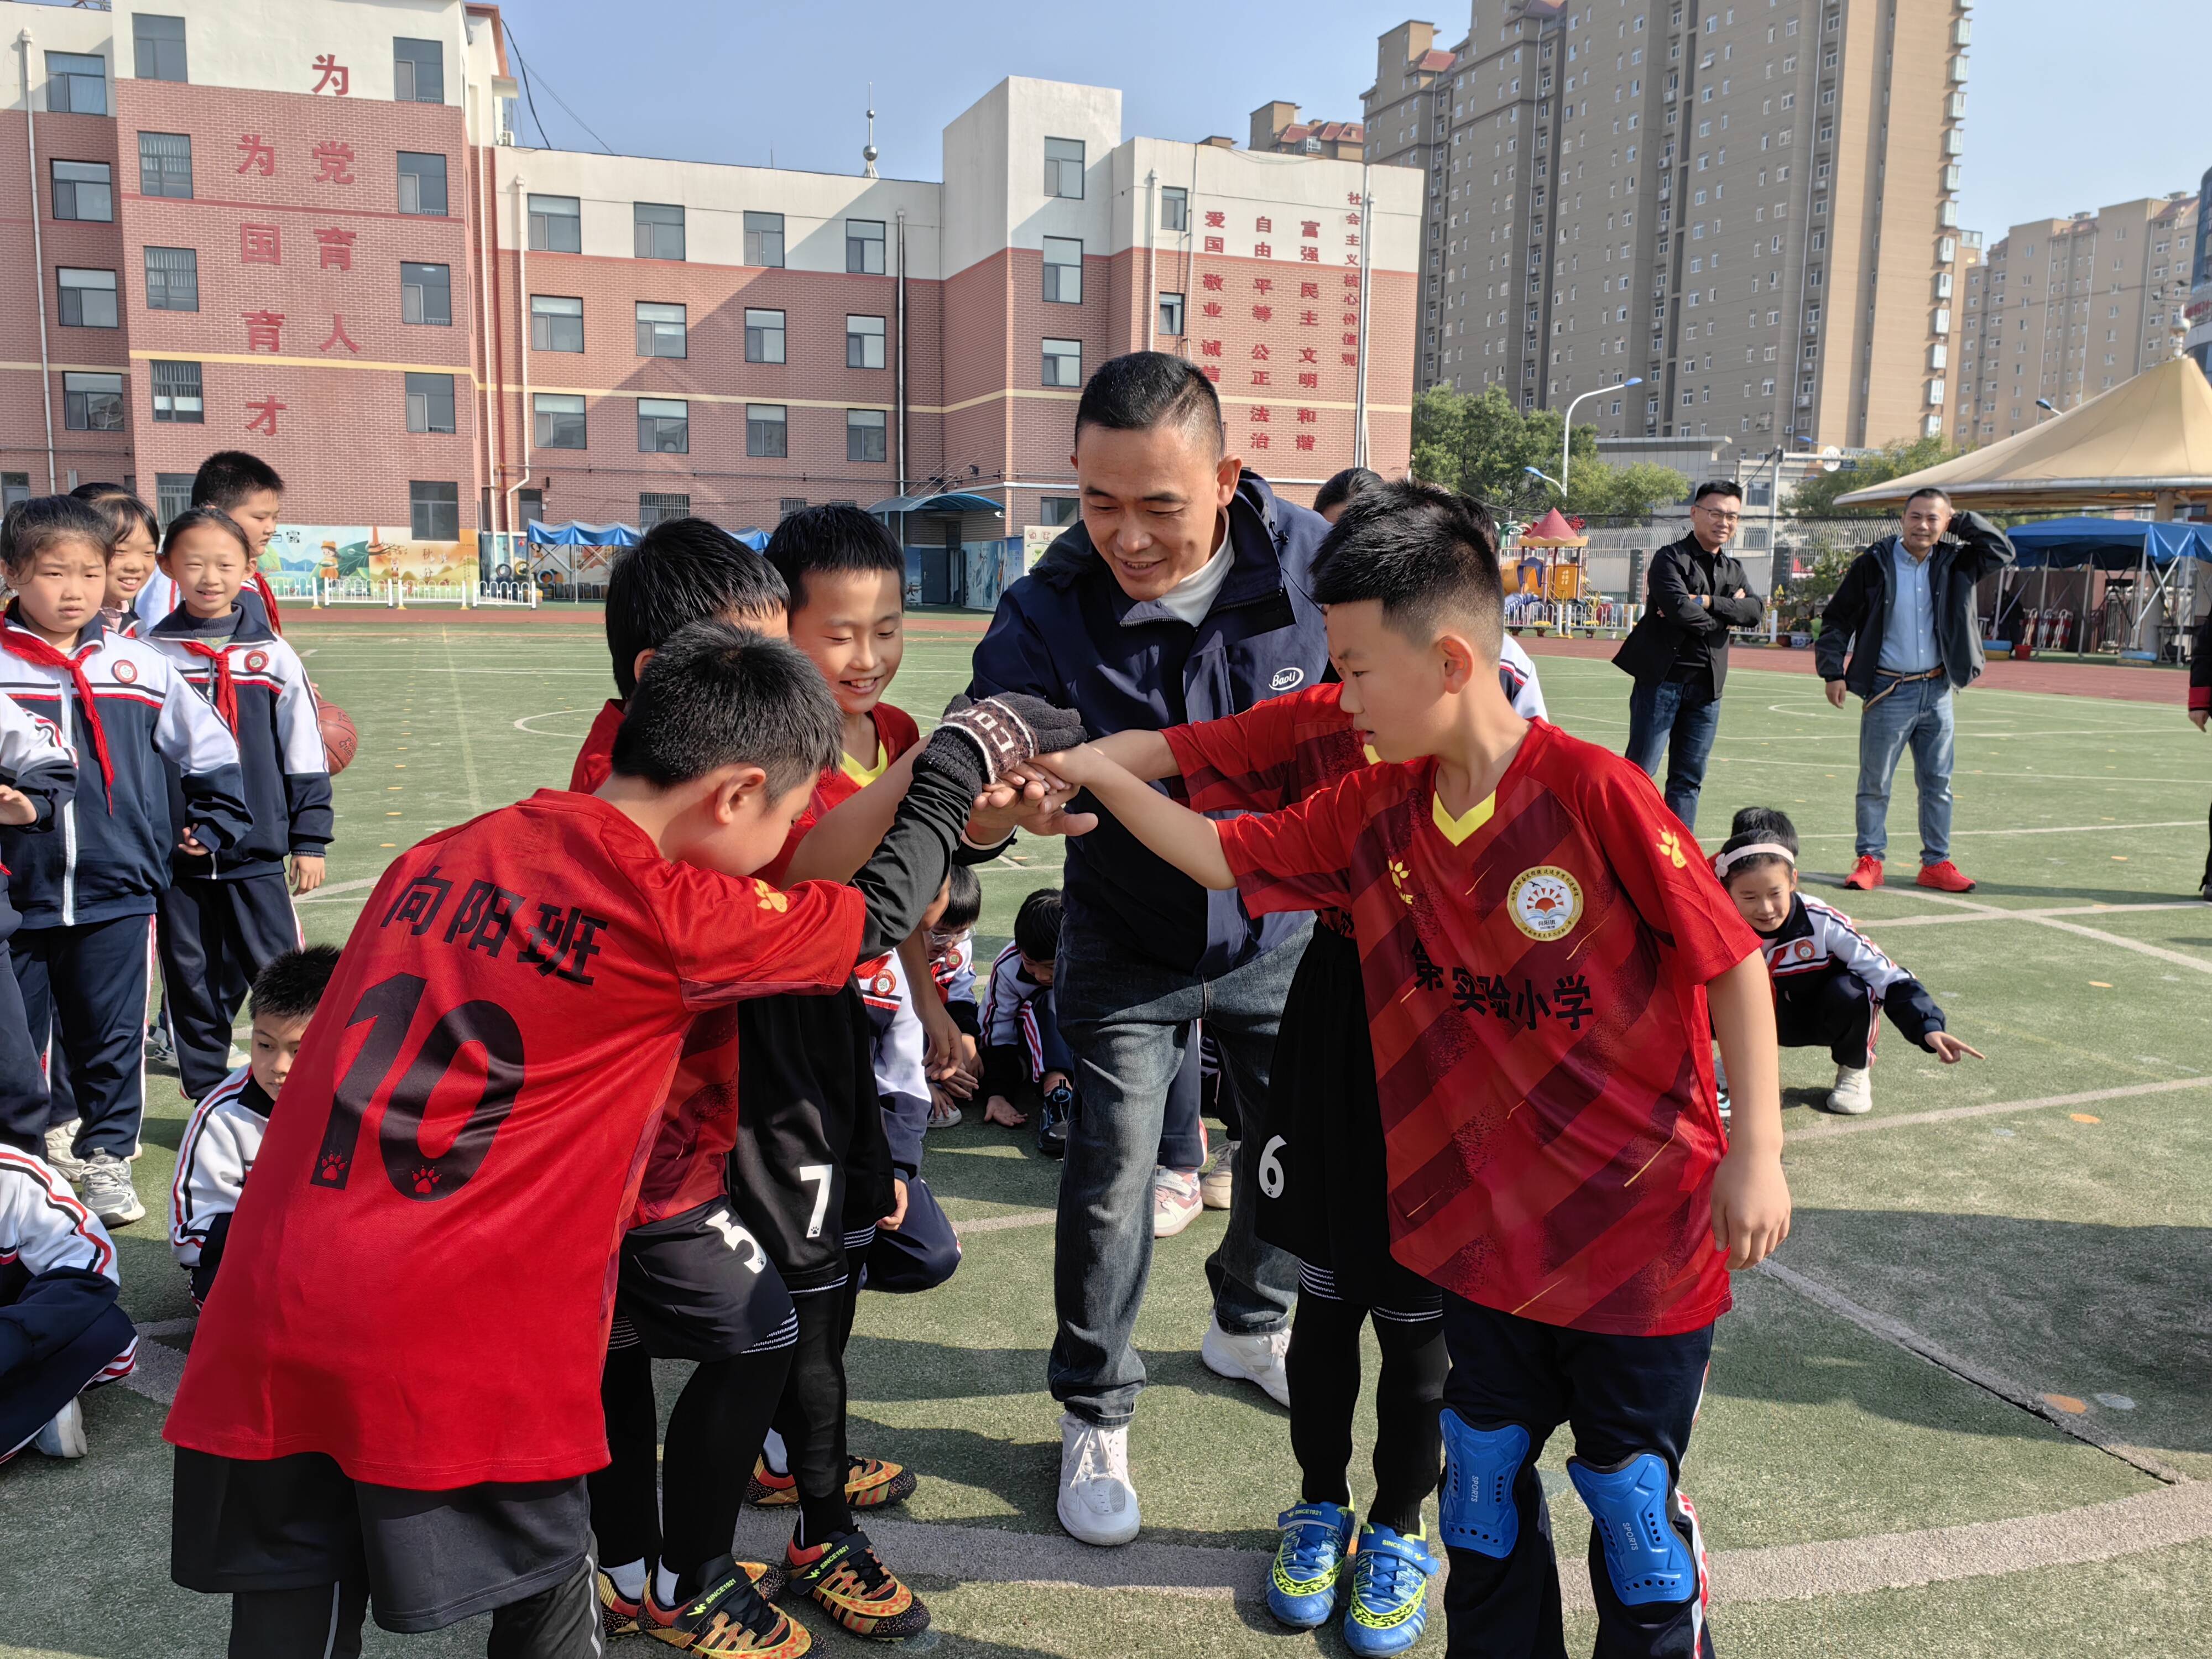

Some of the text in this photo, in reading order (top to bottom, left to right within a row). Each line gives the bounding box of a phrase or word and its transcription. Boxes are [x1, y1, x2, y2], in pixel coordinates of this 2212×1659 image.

[1272, 671, 1296, 687] Baoli
[380, 865, 608, 986] 向阳班
[310, 972, 525, 1203] 10
[1259, 1135, 1287, 1199] 6
[800, 1164, 832, 1238] 7
[1470, 1475, 1479, 1503] SPORTS
[1622, 1521, 1639, 1551] SPORTS
[820, 1545, 849, 1569] SINCE1921
[706, 1578, 737, 1604] SINCE1921
